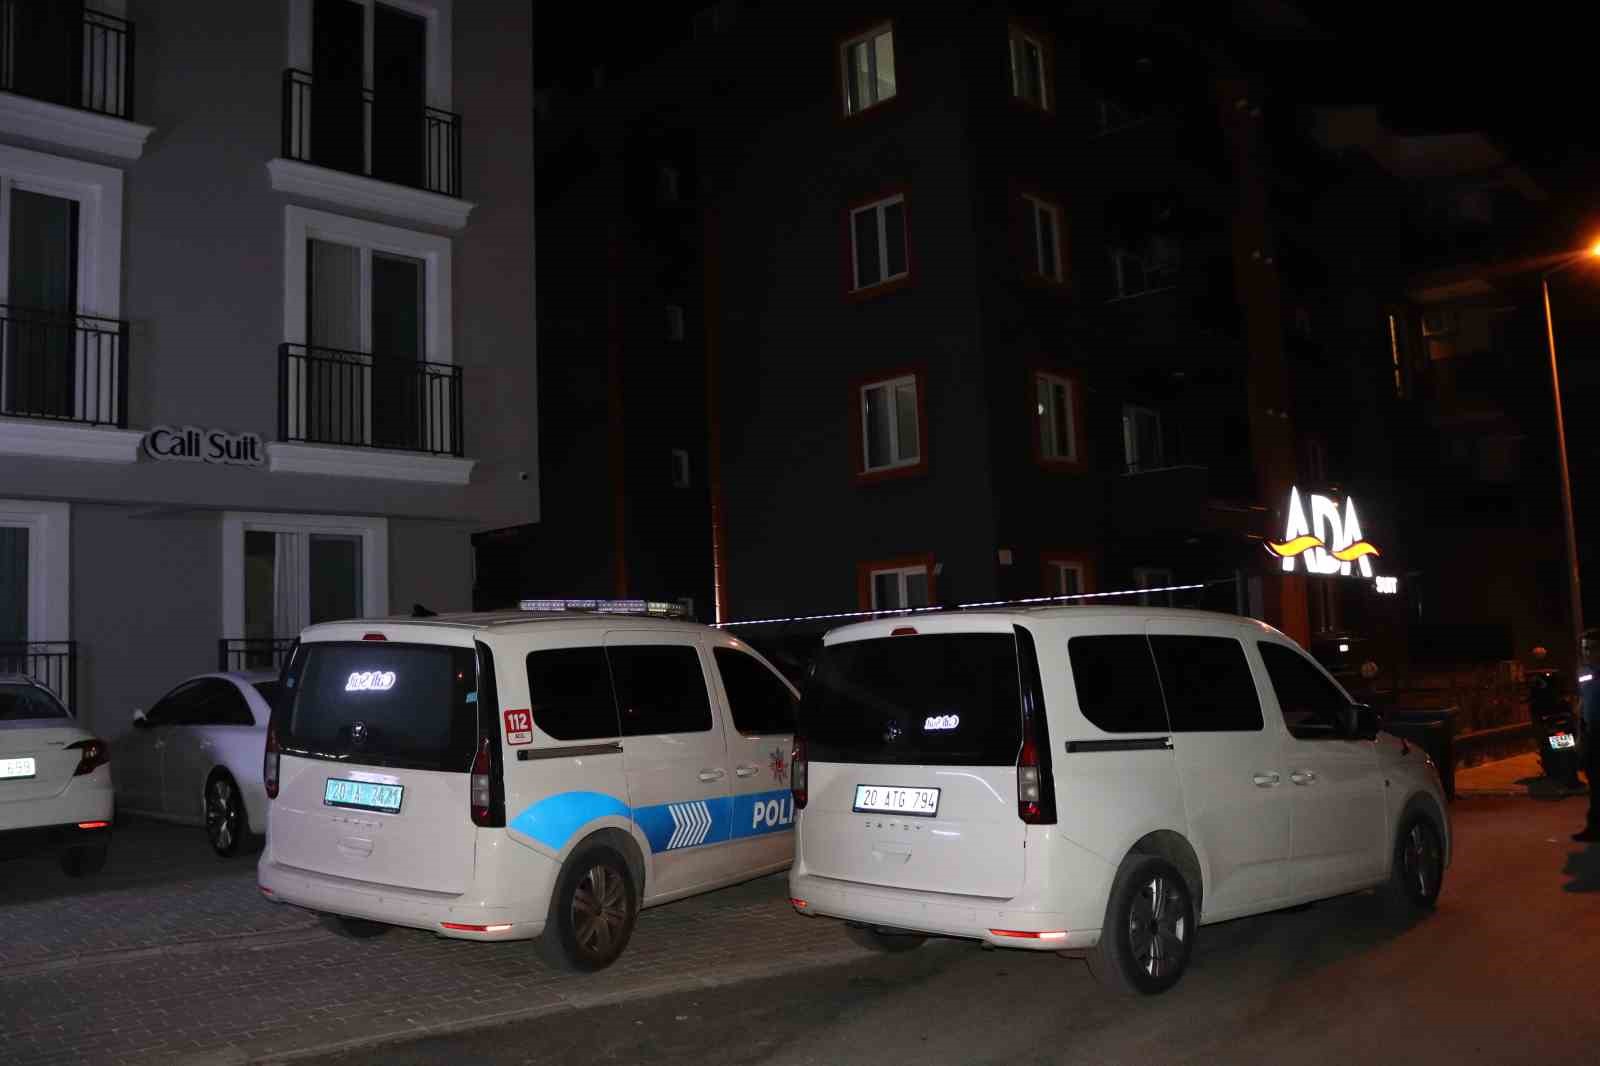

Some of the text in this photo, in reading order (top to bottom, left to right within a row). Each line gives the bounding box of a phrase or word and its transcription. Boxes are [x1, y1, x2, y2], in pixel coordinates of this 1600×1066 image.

[150, 430, 261, 461] Cali Suit
[1282, 485, 1373, 578] ADA
[508, 713, 529, 731] 112
[863, 789, 934, 809] 20 ATG 794
